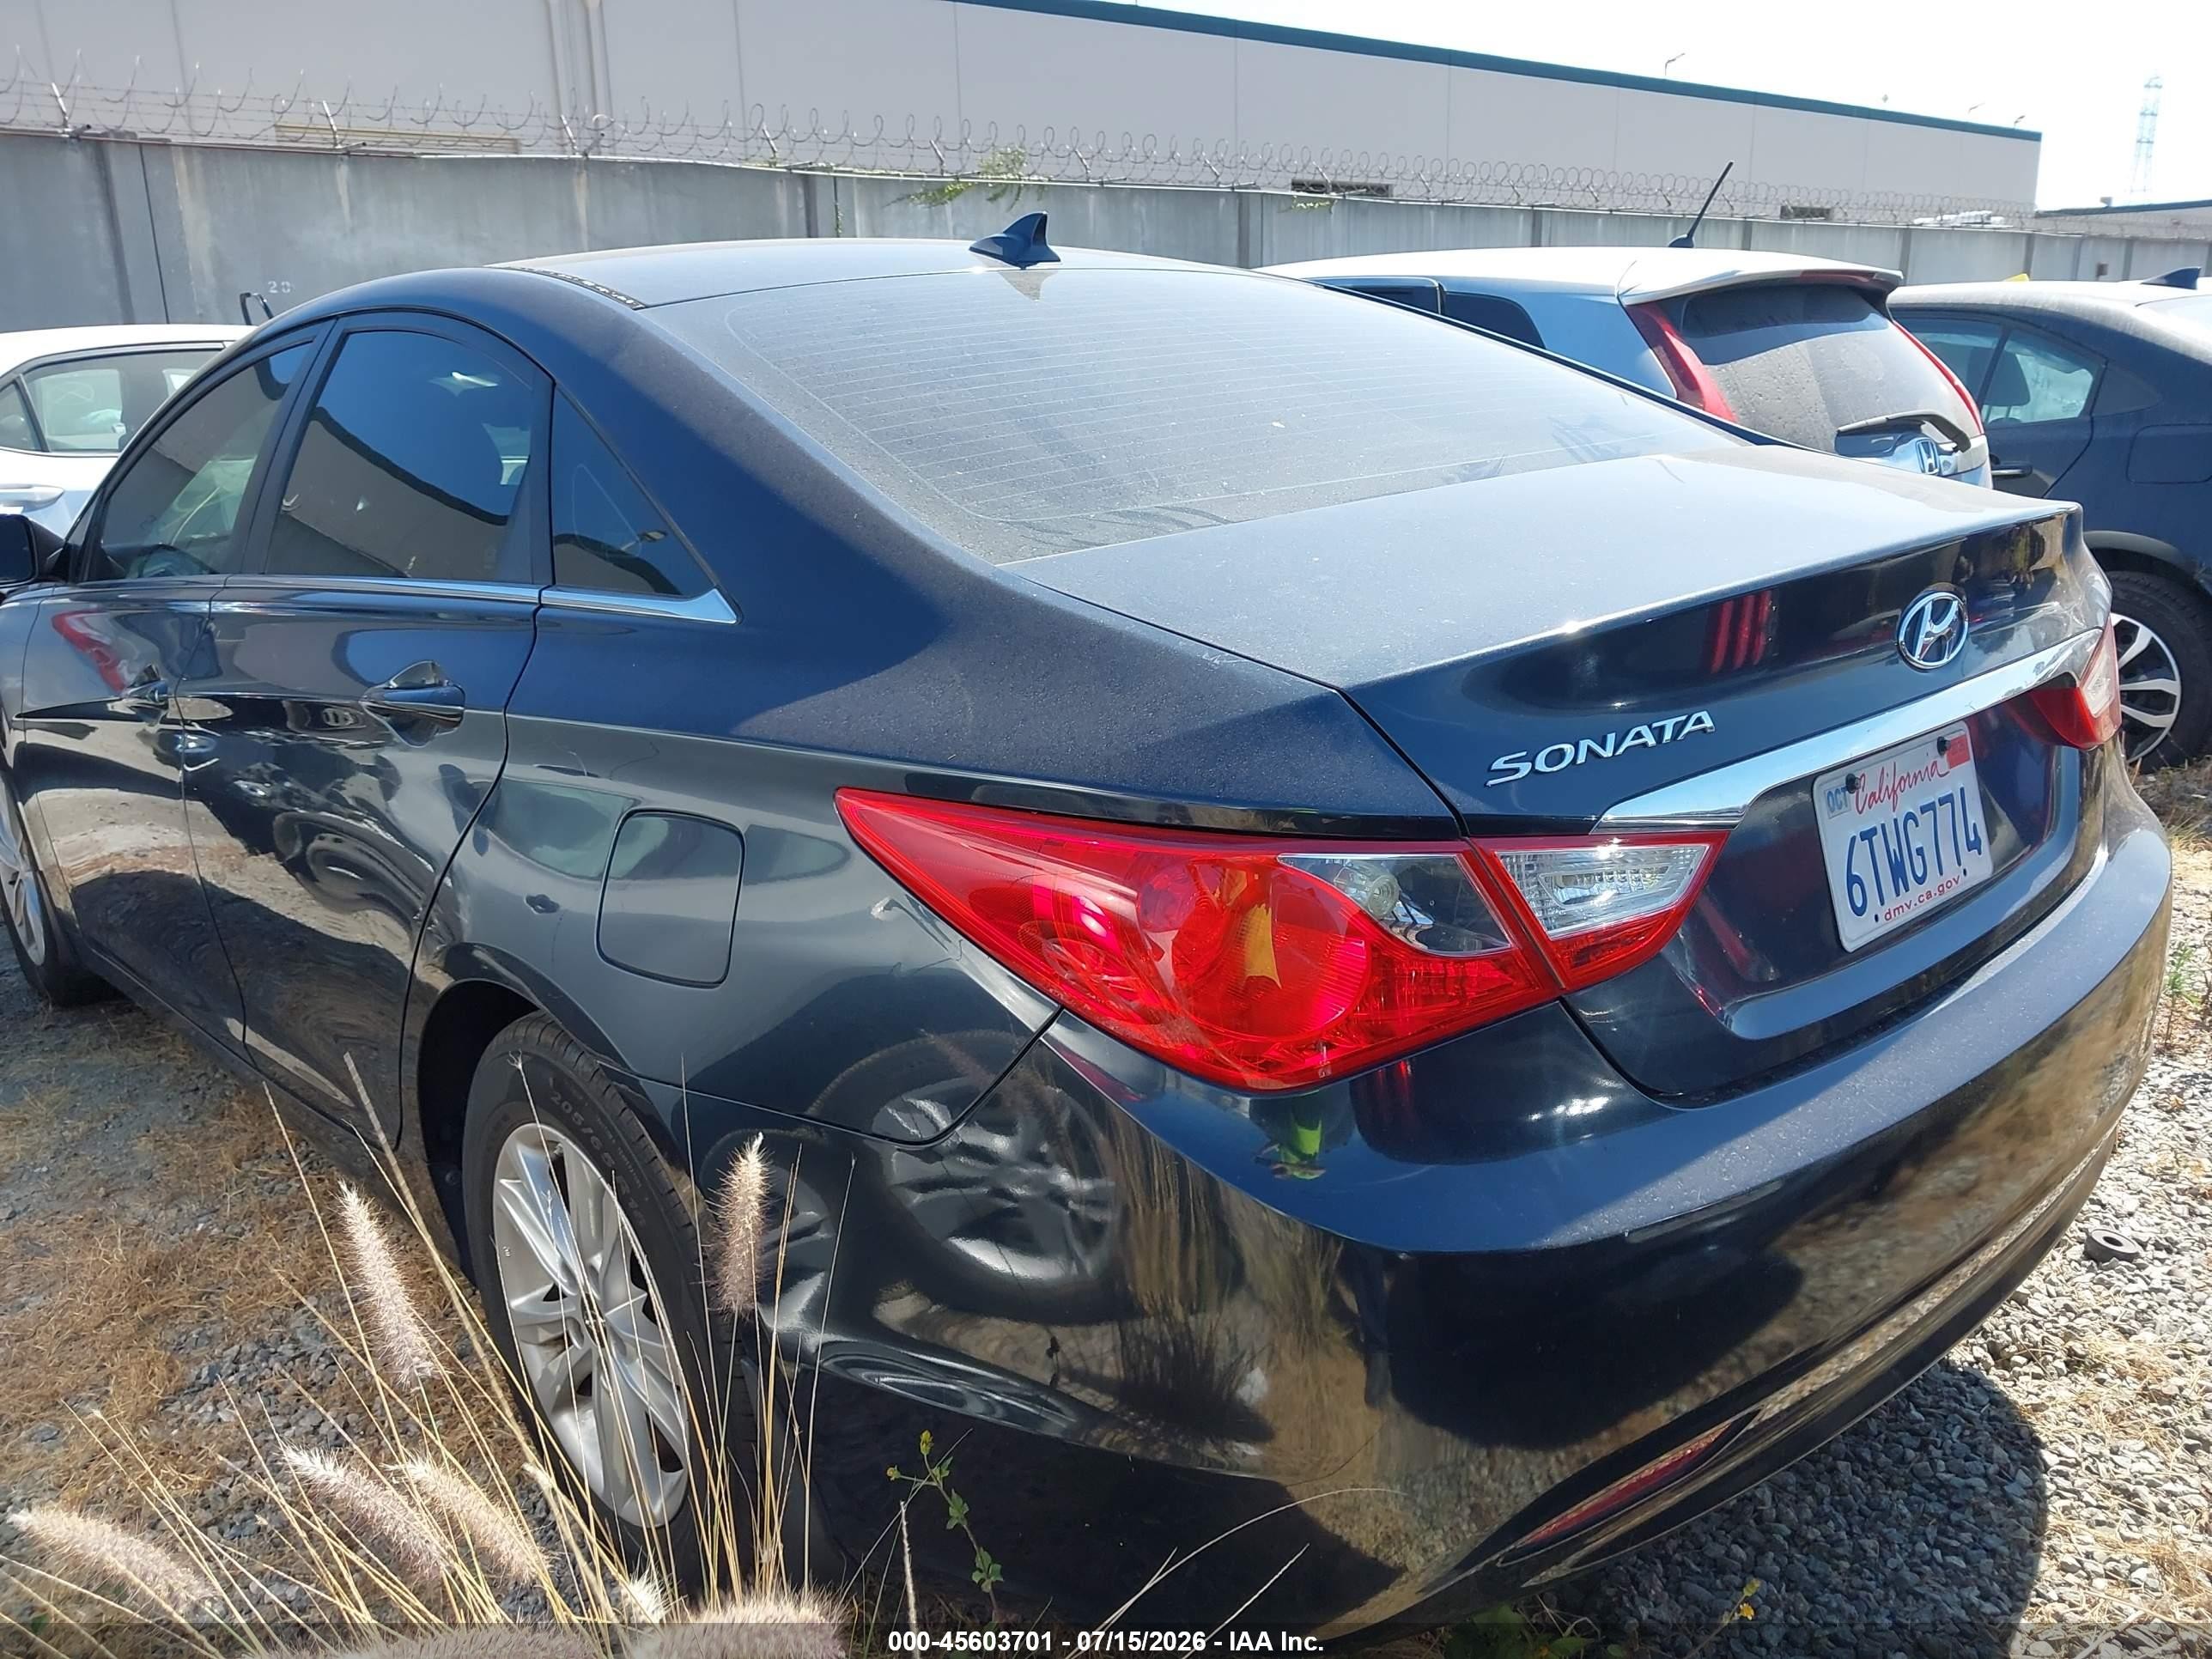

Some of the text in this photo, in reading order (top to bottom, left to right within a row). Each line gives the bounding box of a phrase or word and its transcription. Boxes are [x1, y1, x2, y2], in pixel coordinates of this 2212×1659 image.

[1485, 709, 1717, 788] SONATA
[1826, 785, 1850, 813] OCT
[1855, 760, 1950, 815] California
[1846, 787, 1983, 917] 6TWG774
[1884, 875, 1961, 921] dmv.ca.gov
